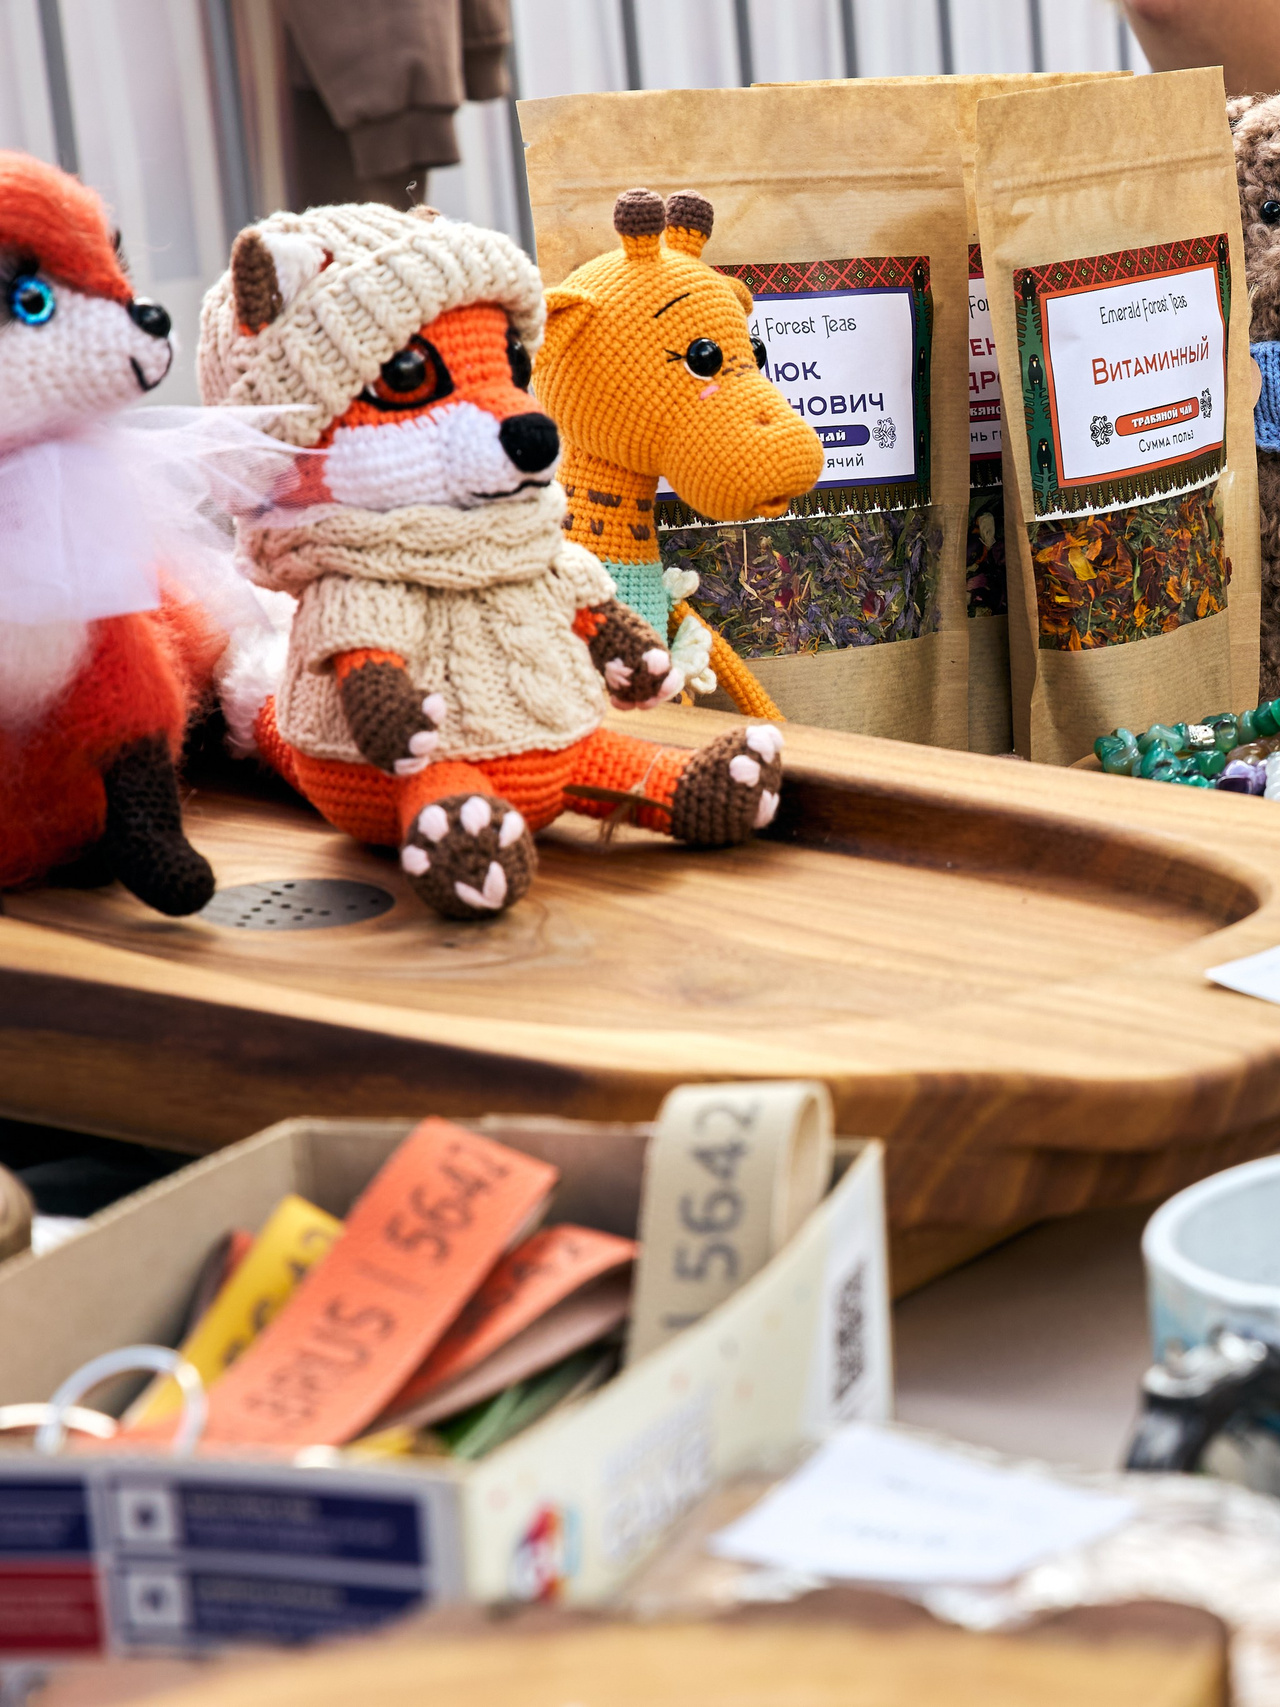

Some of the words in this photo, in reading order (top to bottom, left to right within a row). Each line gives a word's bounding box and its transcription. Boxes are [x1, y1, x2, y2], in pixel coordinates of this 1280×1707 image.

[1100, 300, 1141, 324] Emerald
[1142, 298, 1169, 322] Forest
[1168, 293, 1187, 315] Teas
[765, 317, 816, 342] Forest
[822, 315, 857, 339] Teas
[673, 1102, 762, 1283] 5642
